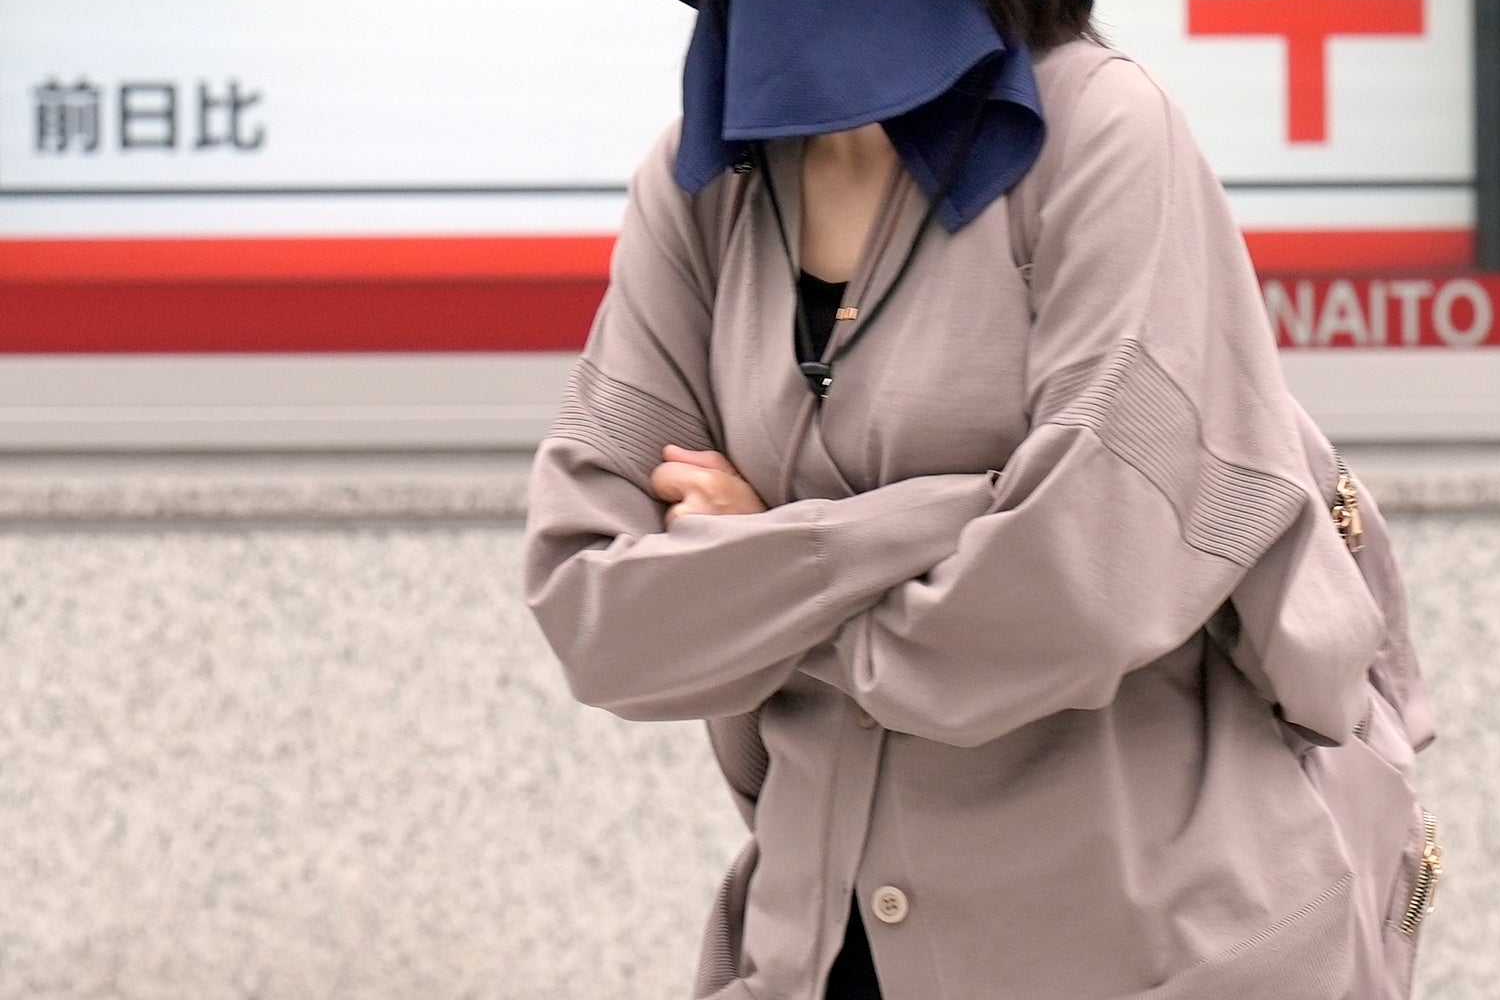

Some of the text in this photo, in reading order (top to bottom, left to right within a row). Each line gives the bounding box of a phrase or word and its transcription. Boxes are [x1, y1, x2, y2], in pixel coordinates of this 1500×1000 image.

[33, 75, 266, 155] 前日比
[1262, 278, 1494, 348] NAITO
